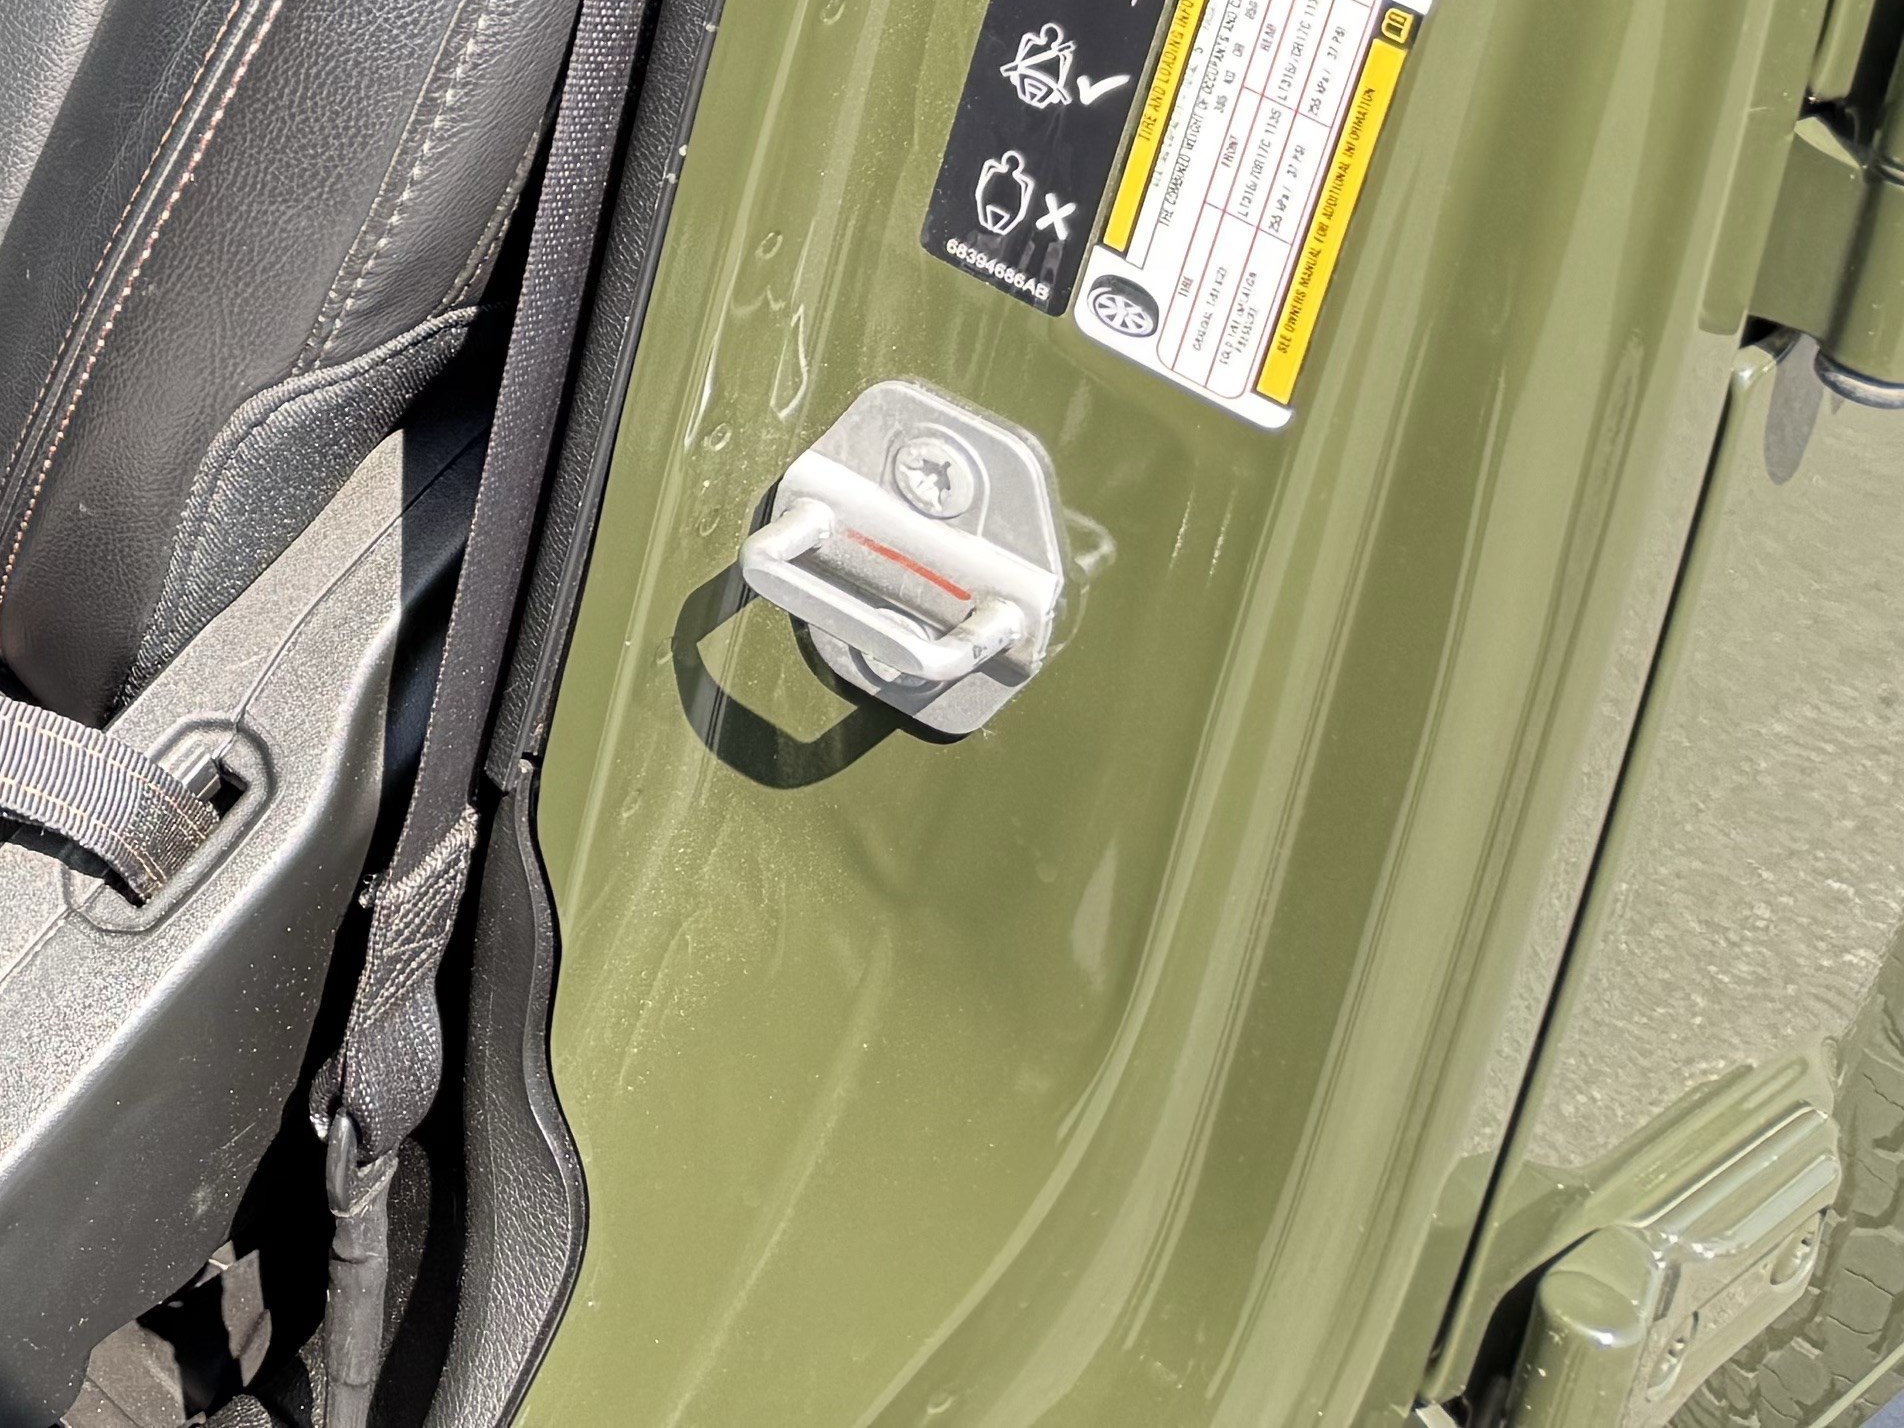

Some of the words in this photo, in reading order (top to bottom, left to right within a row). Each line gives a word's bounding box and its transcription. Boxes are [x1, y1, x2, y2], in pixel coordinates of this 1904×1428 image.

[1156, 28, 1184, 85] LOADING
[1147, 83, 1166, 113] AND
[1341, 84, 1374, 158] INFORMATION
[1137, 111, 1157, 142] TIRE
[1320, 158, 1349, 221] ADDITIONAL
[1313, 219, 1329, 244] FOR
[946, 237, 1050, 301] 68394686AB
[1298, 244, 1321, 290] MANUAL
[1283, 287, 1307, 334] OWNERS
[1276, 332, 1292, 355] SEE
